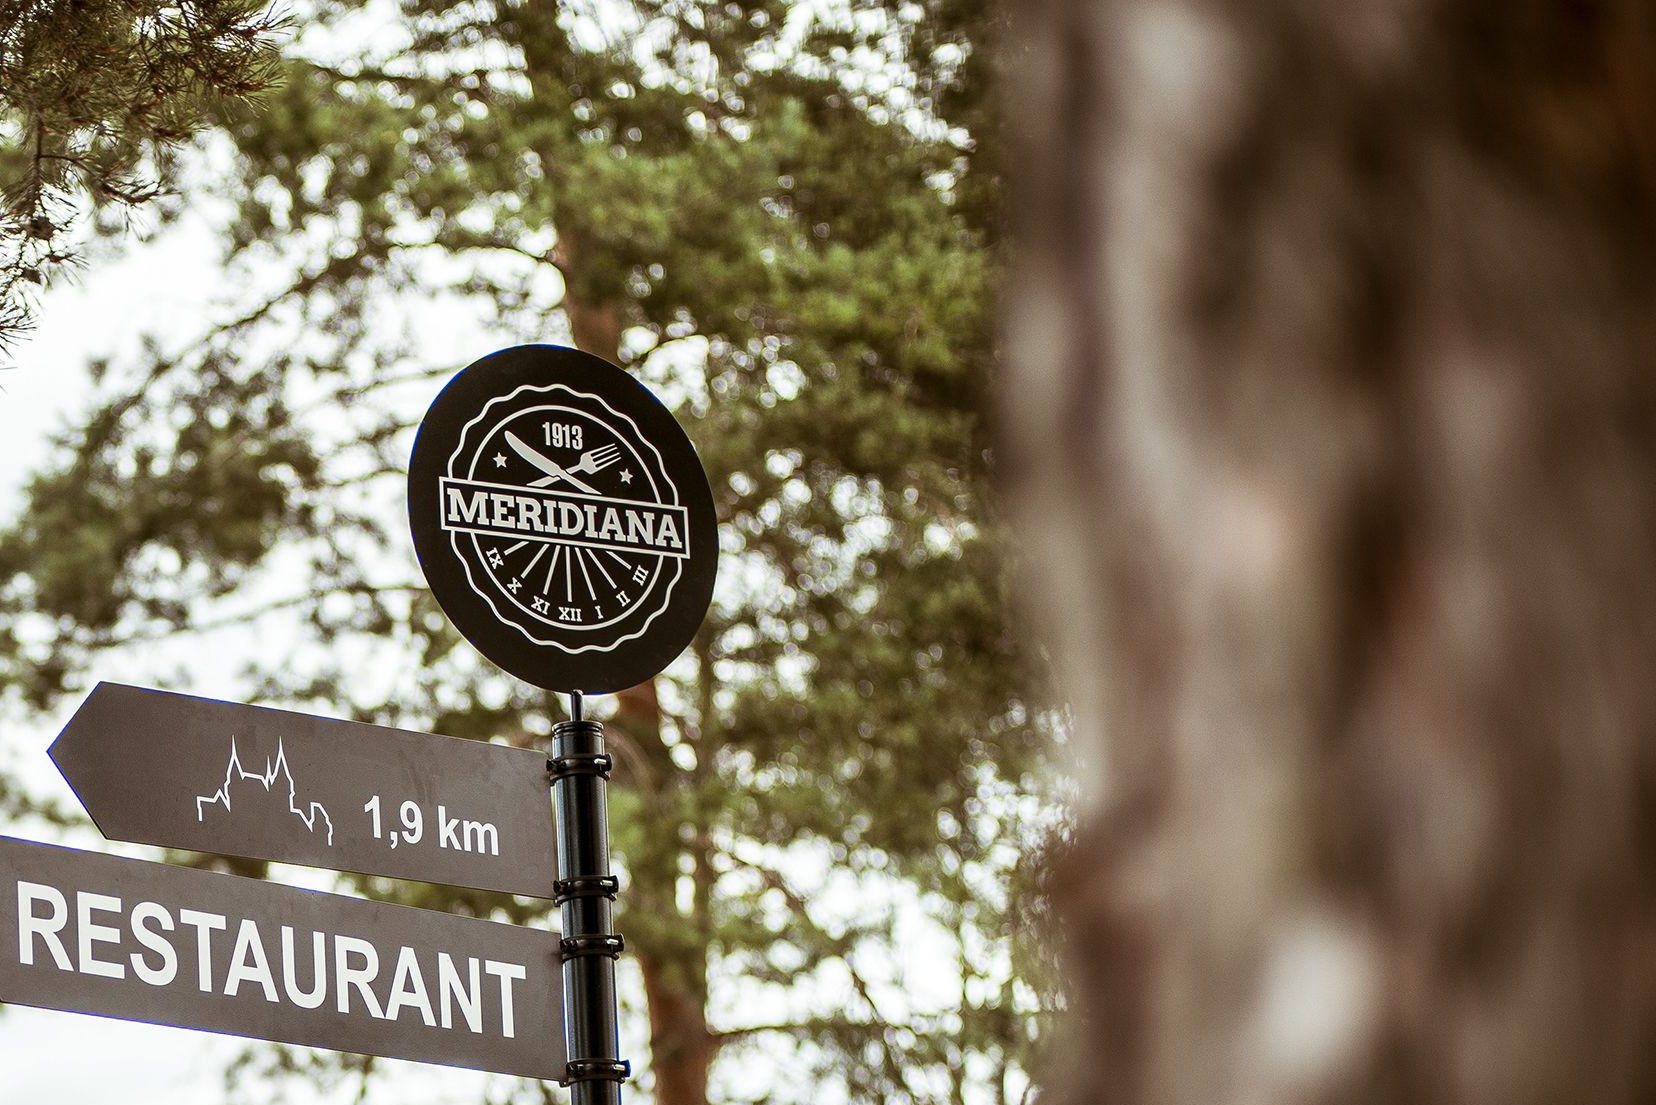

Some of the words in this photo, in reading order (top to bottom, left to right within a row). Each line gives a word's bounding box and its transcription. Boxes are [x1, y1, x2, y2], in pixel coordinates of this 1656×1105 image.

[543, 422, 583, 450] 1913
[447, 487, 682, 548] MERIDIANA
[486, 547, 504, 569] IX
[506, 577, 522, 594] X
[531, 595, 551, 615] XI
[558, 606, 582, 622] XII
[594, 605, 604, 619] I
[615, 590, 631, 607] II
[632, 564, 649, 586] III
[364, 795, 423, 849] 1,9
[438, 805, 500, 856] km
[16, 880, 527, 1039] RESTAURANT
